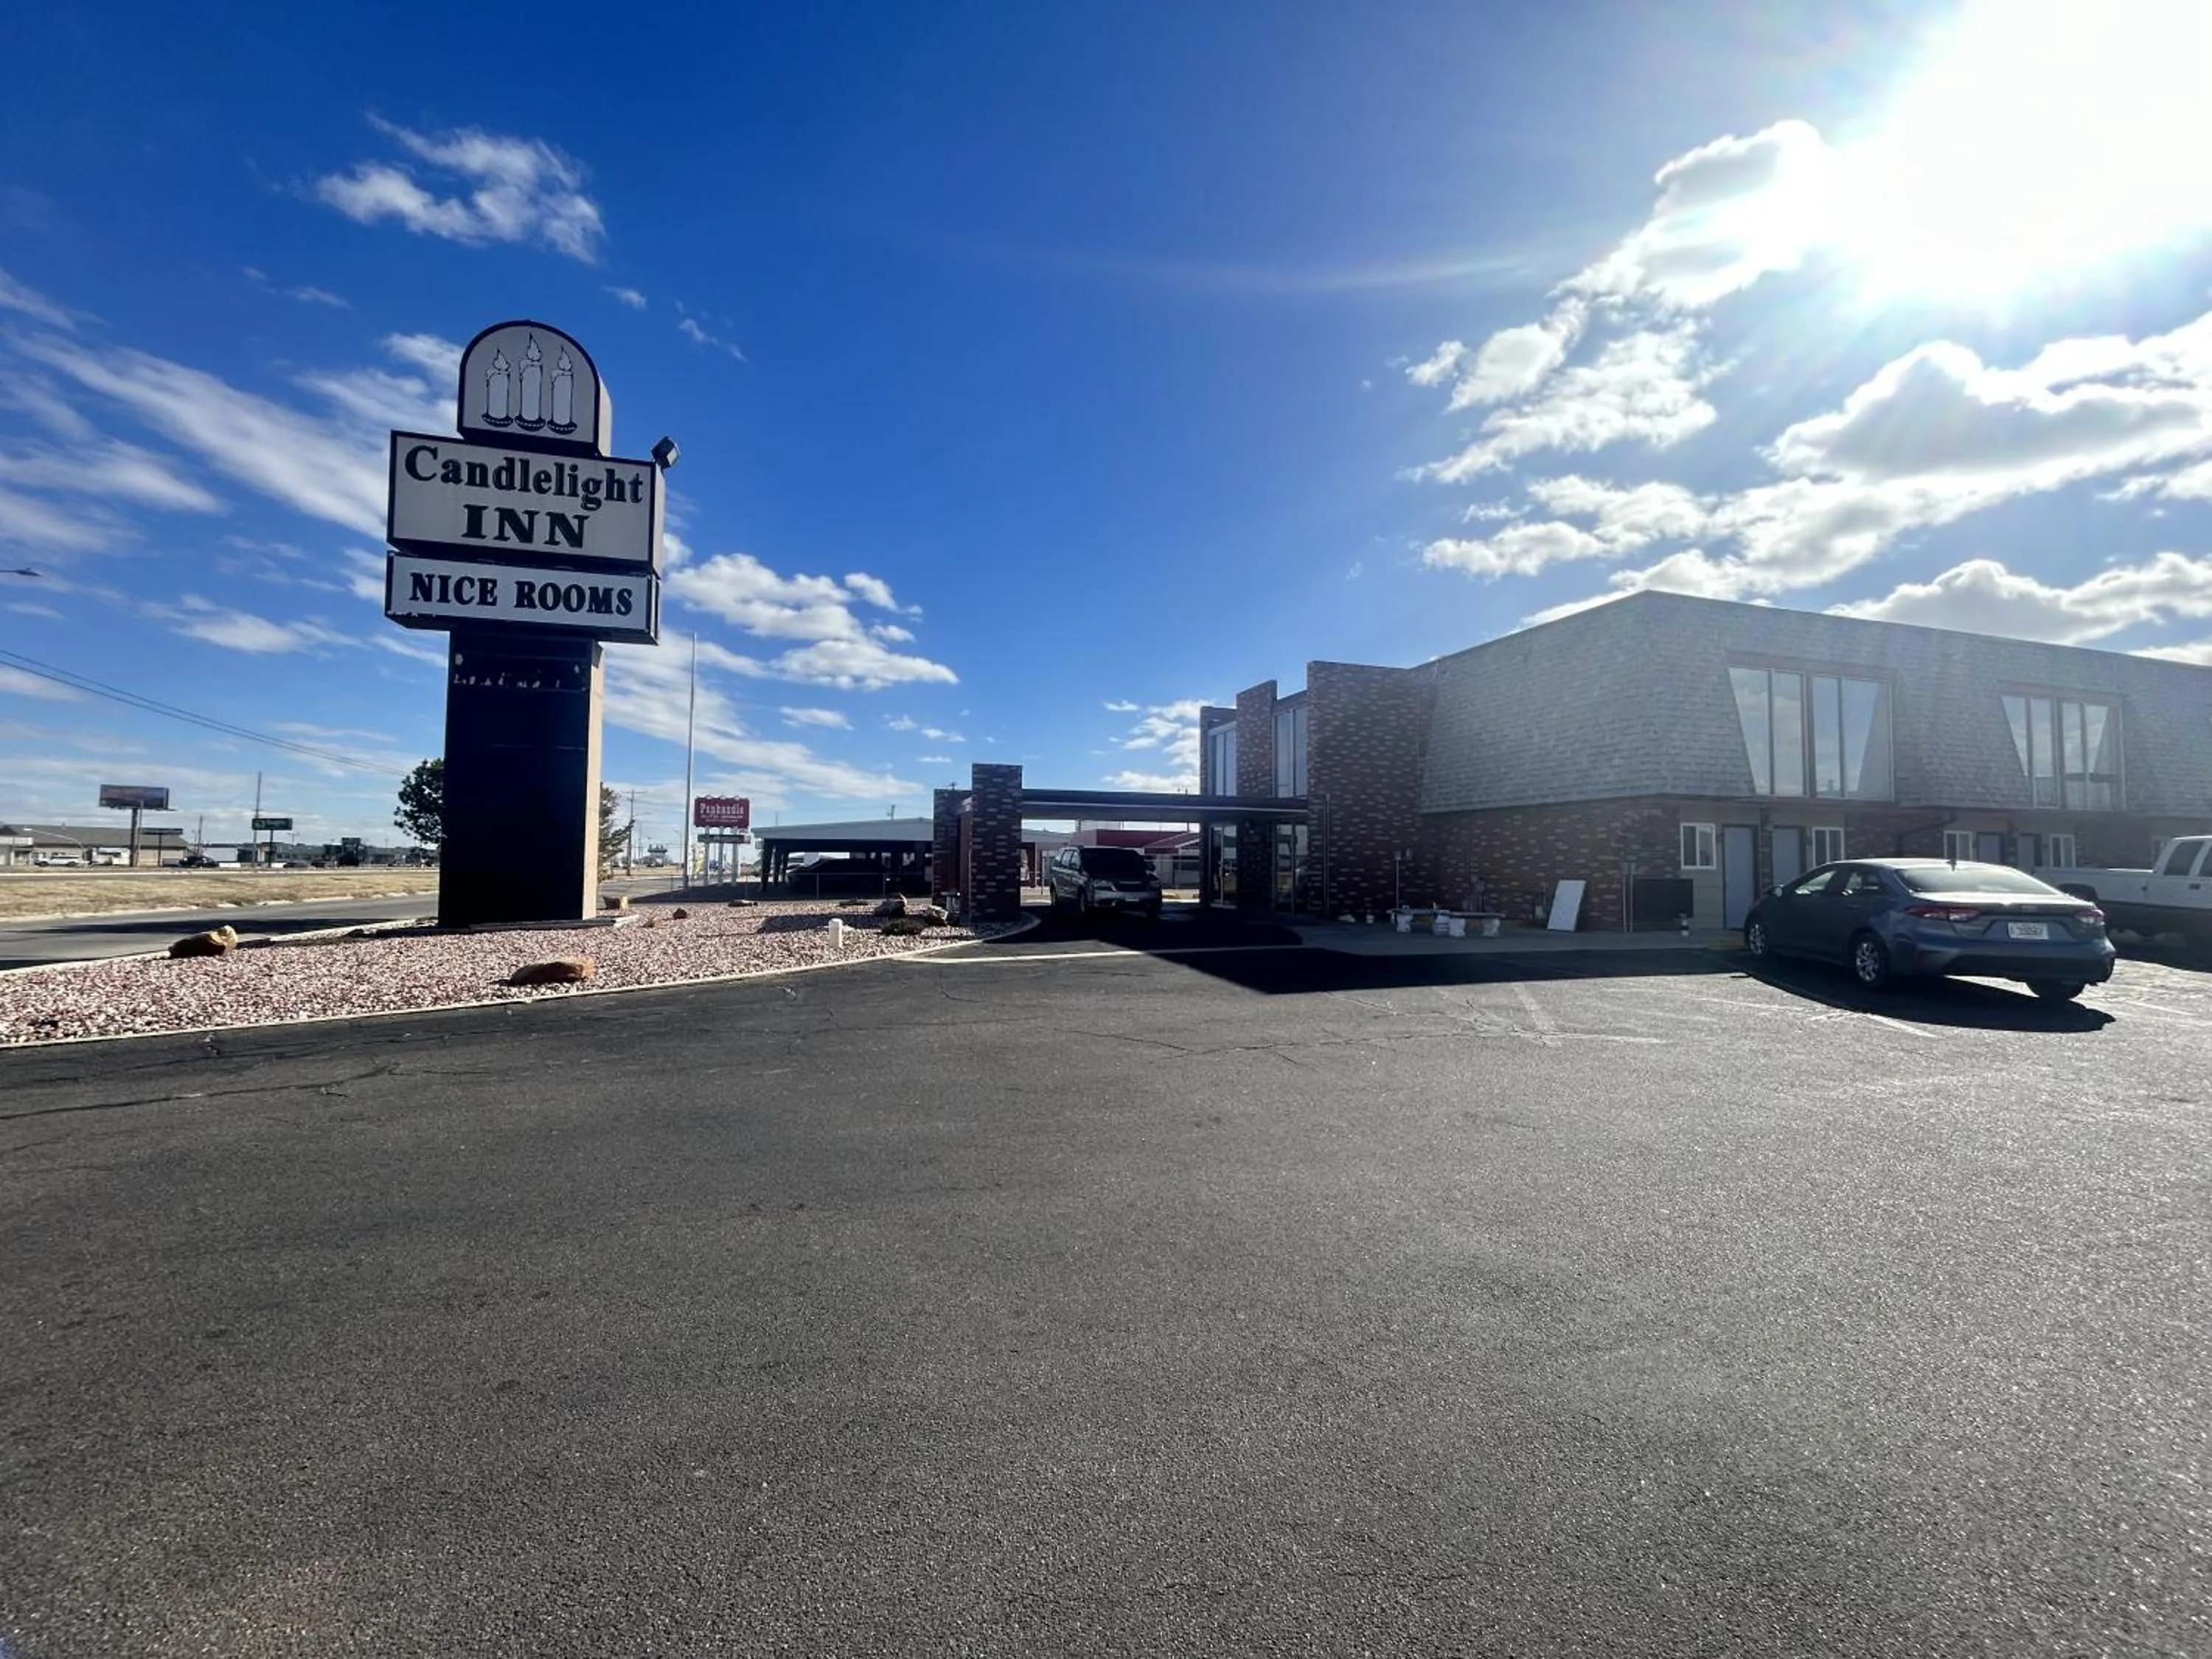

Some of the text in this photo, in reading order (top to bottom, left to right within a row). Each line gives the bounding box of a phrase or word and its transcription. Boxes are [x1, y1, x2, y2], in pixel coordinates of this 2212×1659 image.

[404, 445, 644, 511] Candlelight
[462, 504, 590, 549] INN
[409, 572, 633, 616] NICE ROOMS
